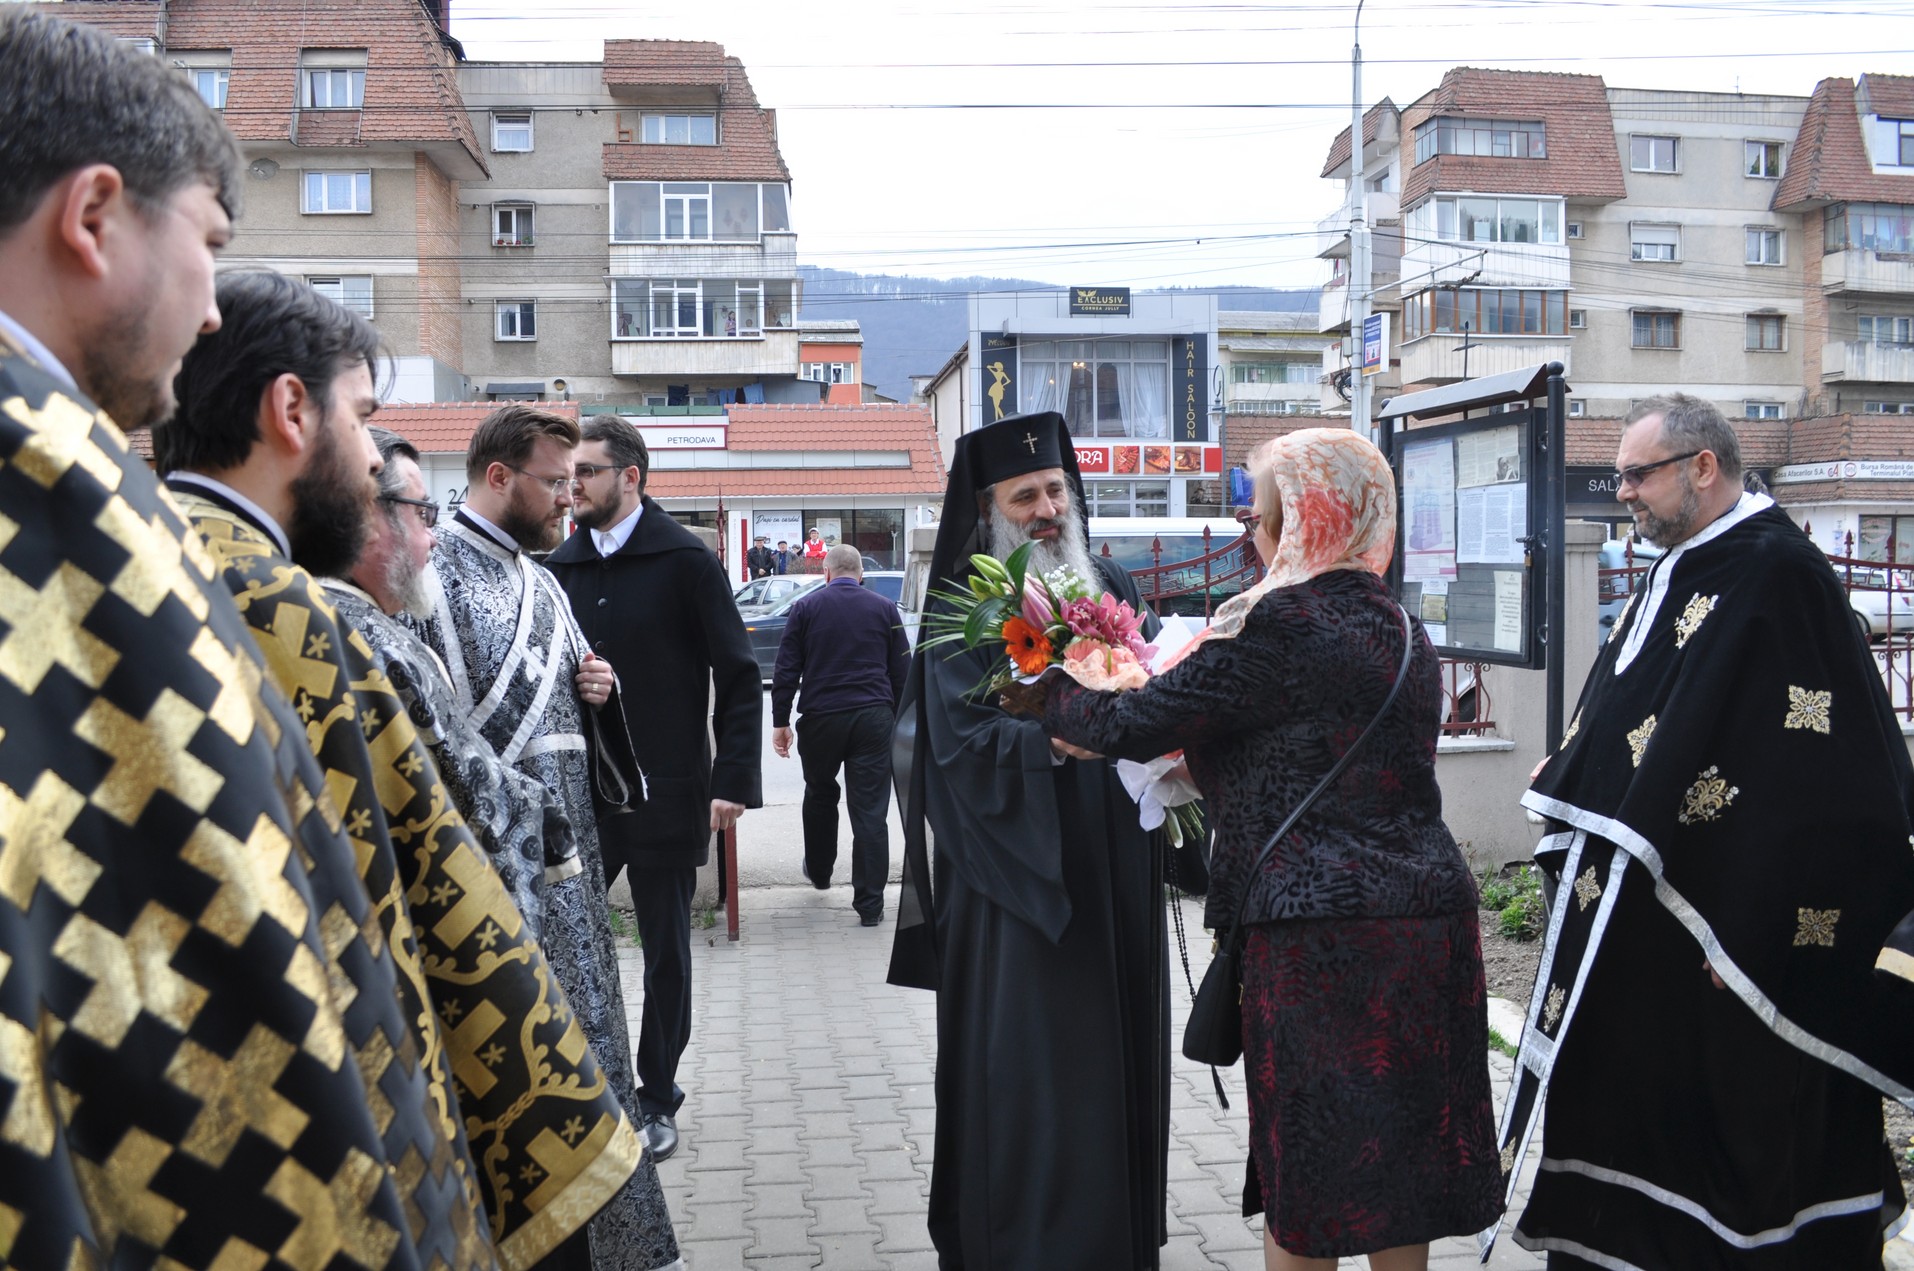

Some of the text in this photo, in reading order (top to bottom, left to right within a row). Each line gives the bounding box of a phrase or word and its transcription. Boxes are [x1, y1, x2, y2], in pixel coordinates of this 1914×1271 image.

[1186, 341, 1196, 439] HAIR SALOON
[667, 436, 717, 444] PETRODAVA
